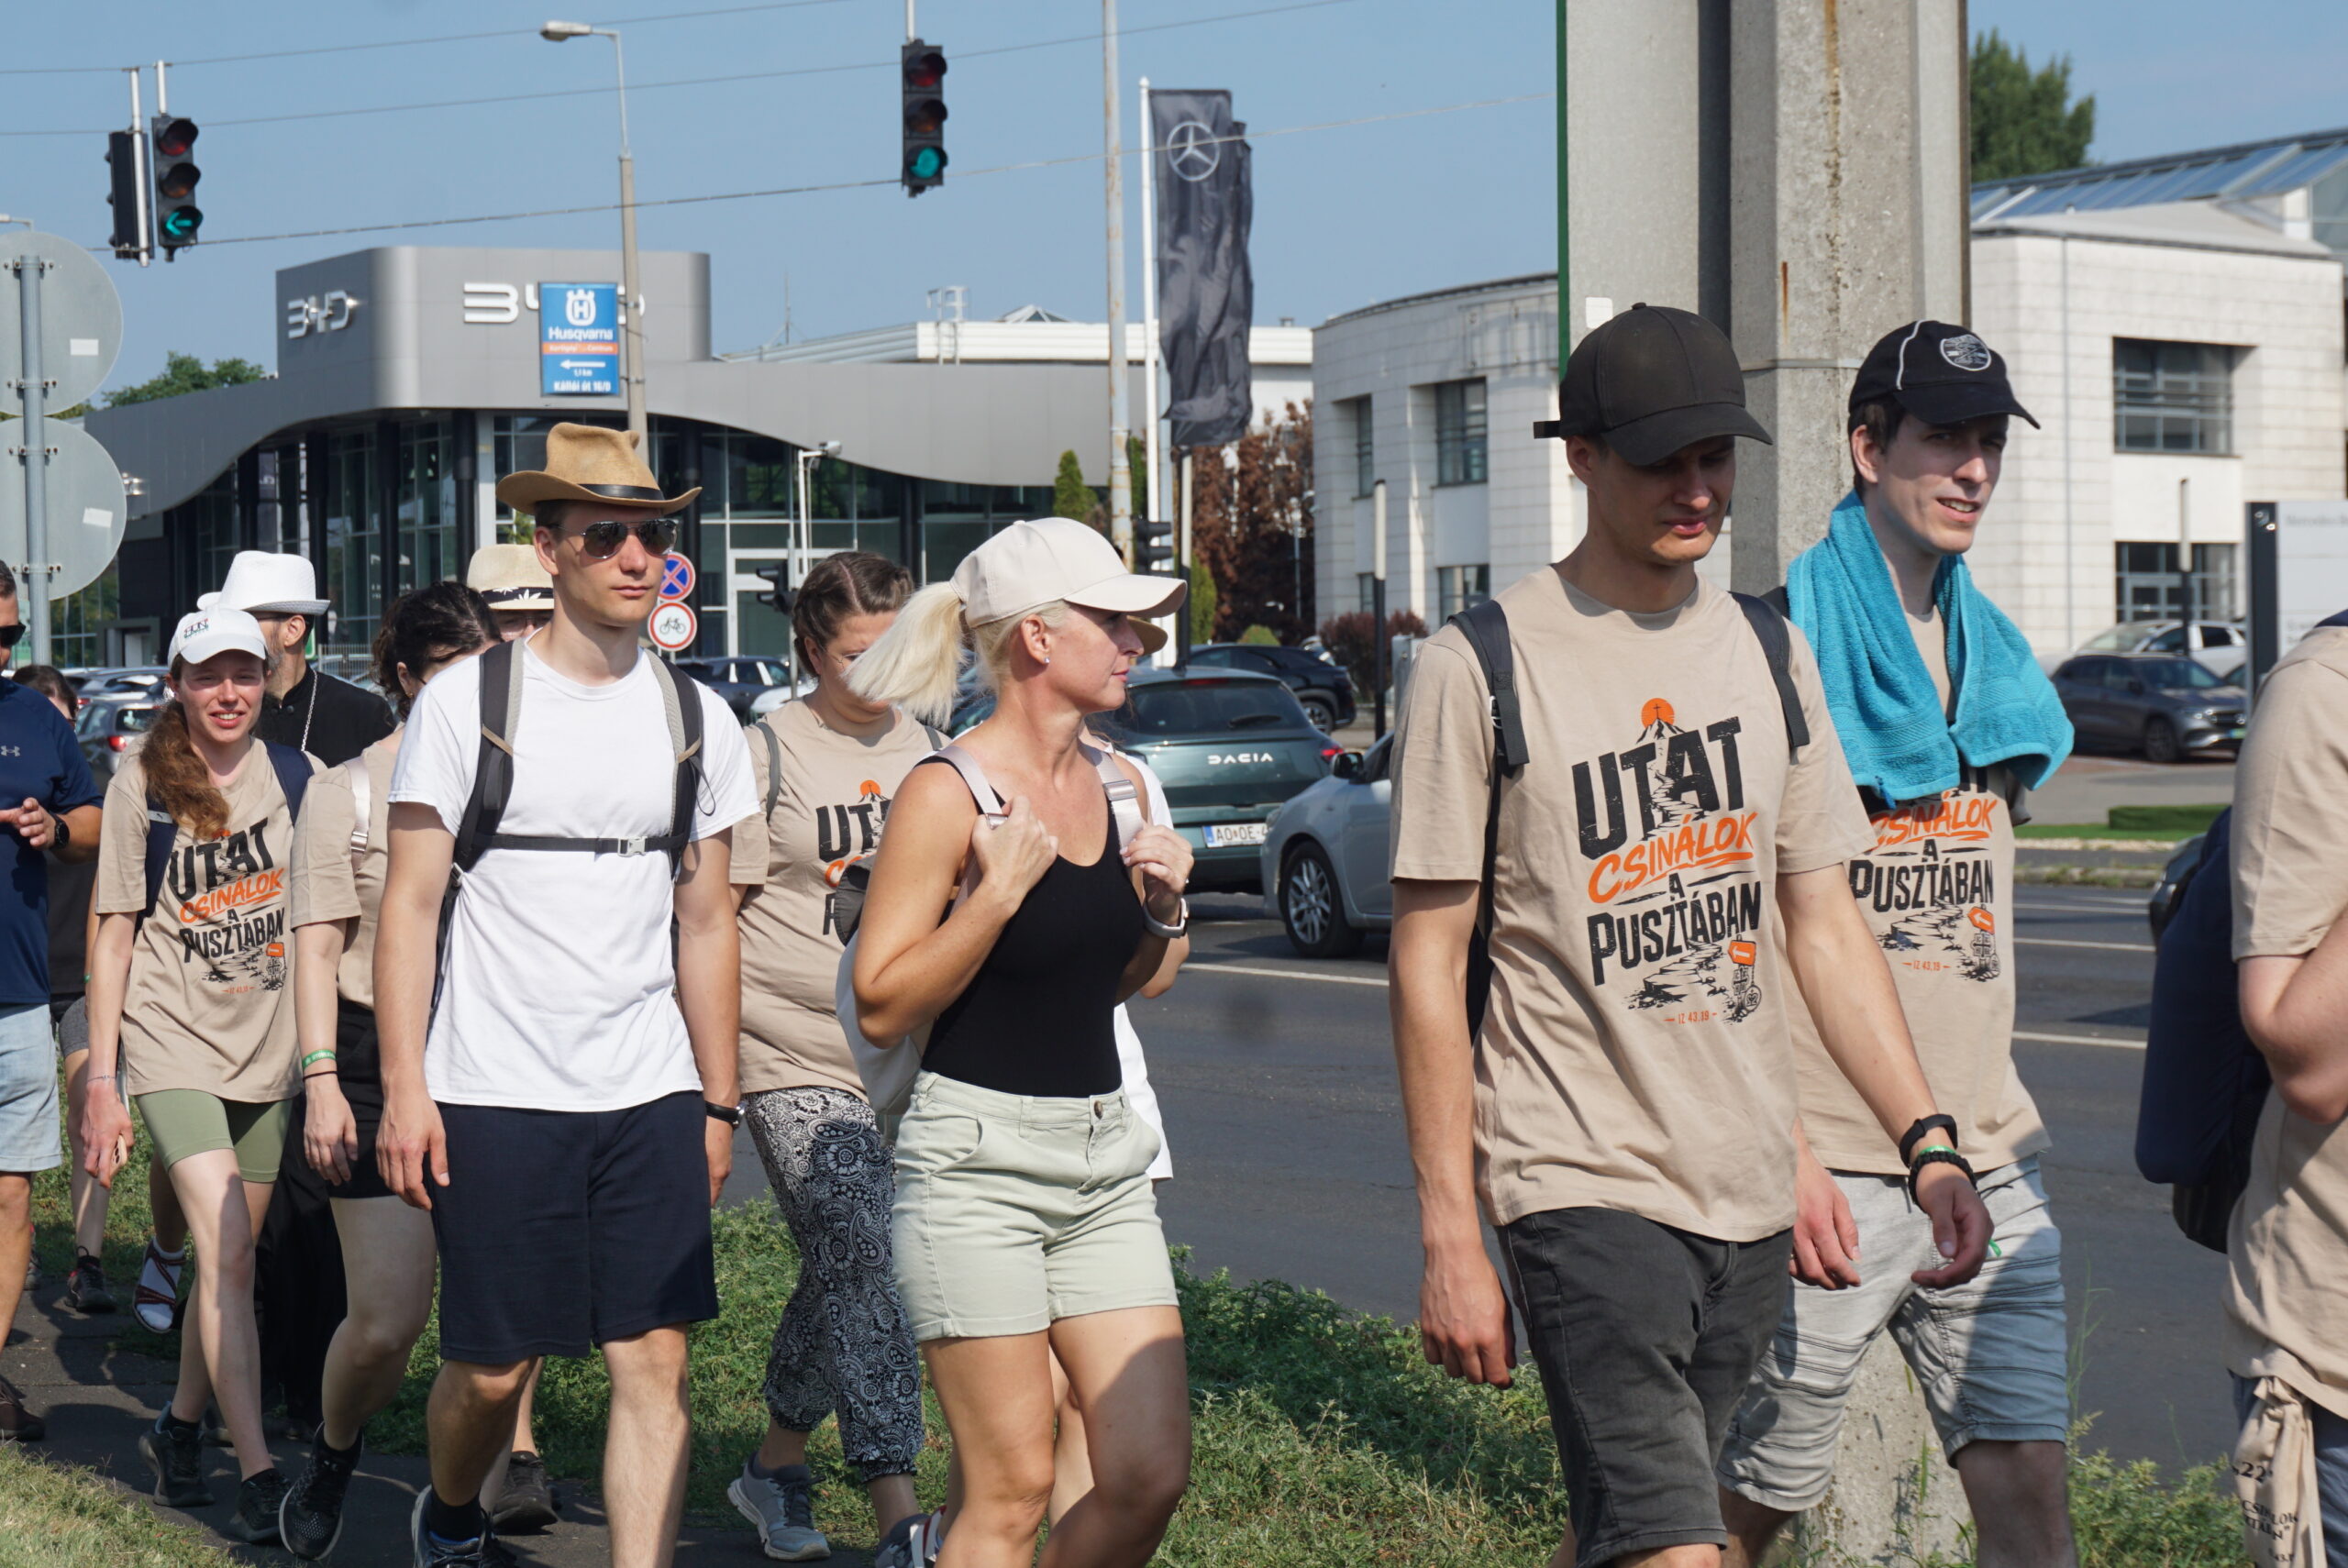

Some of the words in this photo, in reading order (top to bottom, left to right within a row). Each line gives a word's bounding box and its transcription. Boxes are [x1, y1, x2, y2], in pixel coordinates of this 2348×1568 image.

[288, 290, 350, 339] BYD
[548, 326, 614, 341] Husqvarna
[1207, 752, 1274, 764] DACIA
[1571, 716, 1744, 860] UTAT
[169, 817, 274, 901] UTAT
[1588, 812, 1758, 904] CSINÁLOK
[1922, 839, 1938, 862] A
[179, 868, 285, 923] CSINÁLOK
[1669, 872, 1685, 902] A
[1848, 858, 1994, 912] PUSZTÁBAN
[179, 906, 285, 963] PUSZTÁBAN
[227, 908, 239, 924] A
[1587, 880, 1761, 987] PUSZTÁBAN
